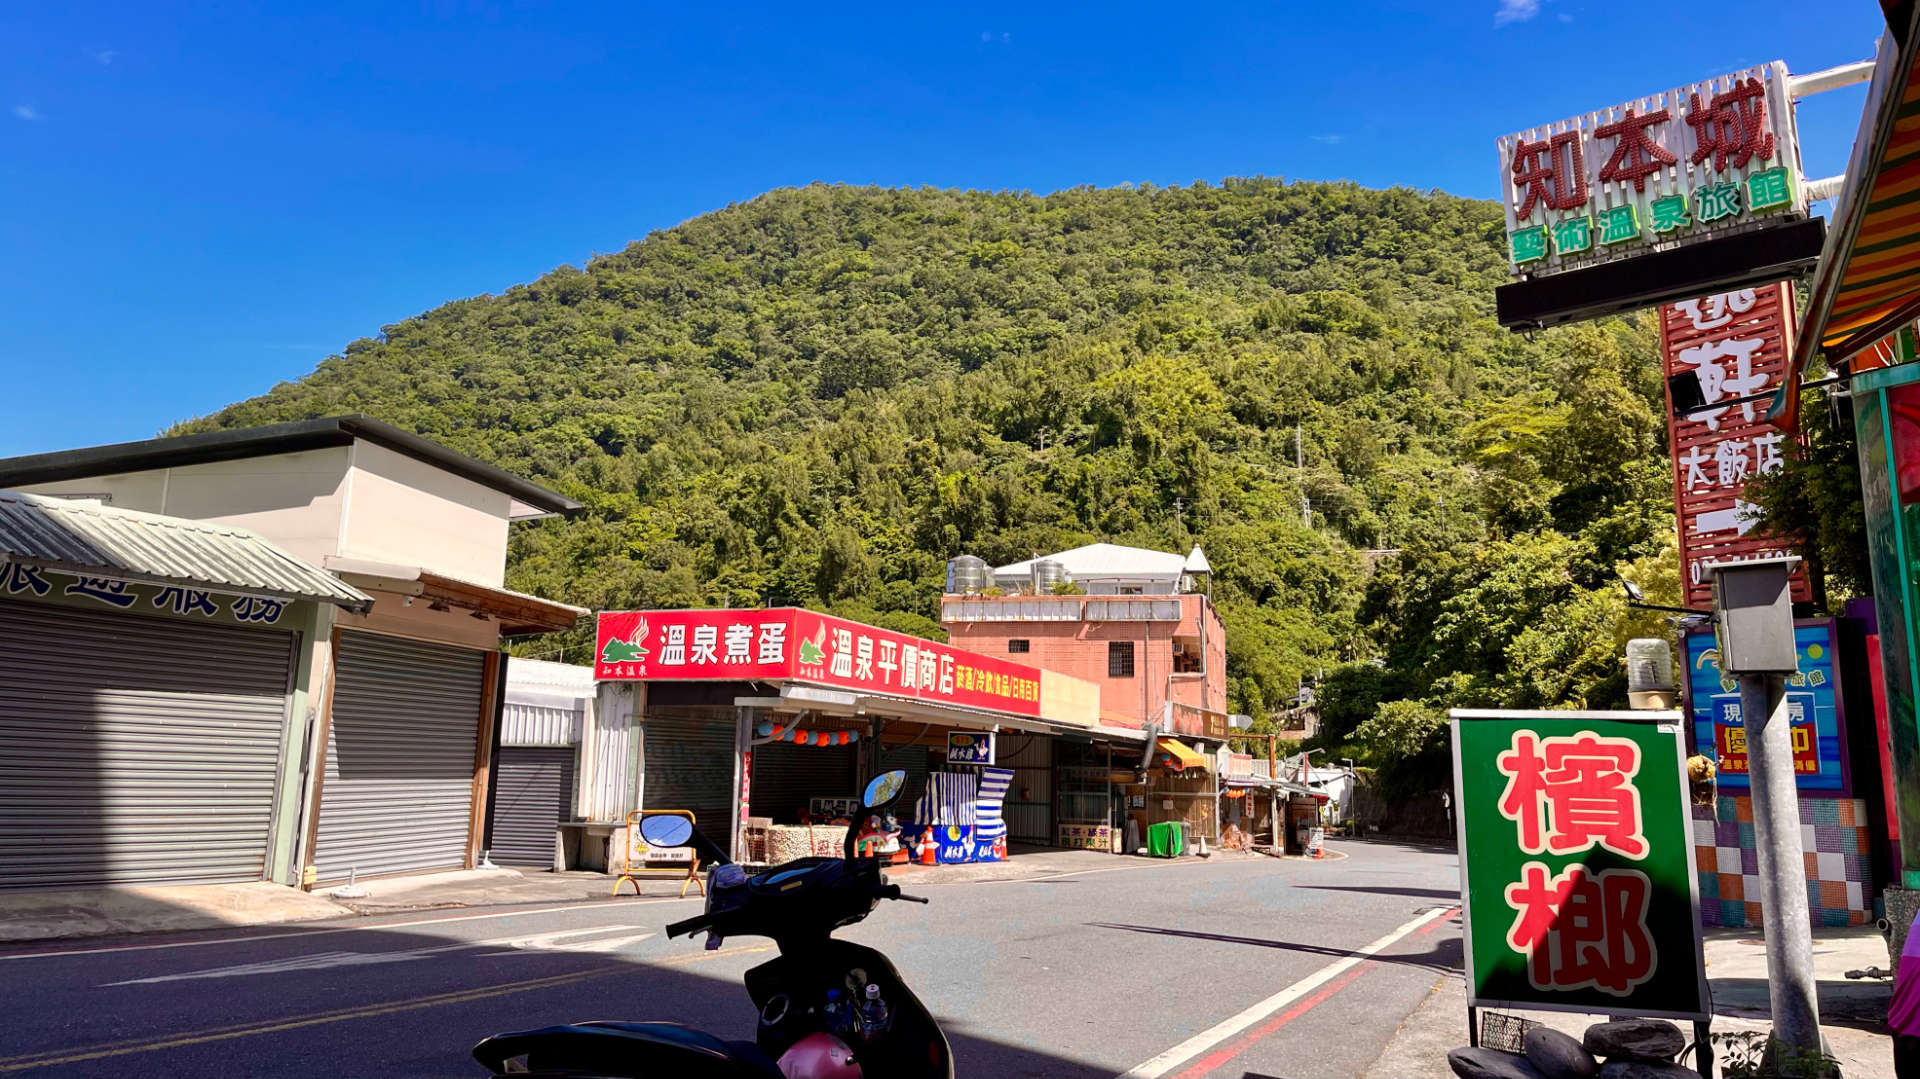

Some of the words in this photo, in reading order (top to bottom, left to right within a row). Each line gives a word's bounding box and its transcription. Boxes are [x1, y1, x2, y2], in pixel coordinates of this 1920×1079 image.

[1511, 77, 1775, 222] 知本城
[1509, 166, 1793, 265] 藝術溫泉旅館
[1679, 433, 1785, 491] 大飯店
[602, 664, 648, 677] 知本溫泉
[658, 623, 787, 666] 溫泉煮蛋
[830, 627, 955, 696] 溫泉平價商店
[1497, 730, 1658, 998] 檳榔
